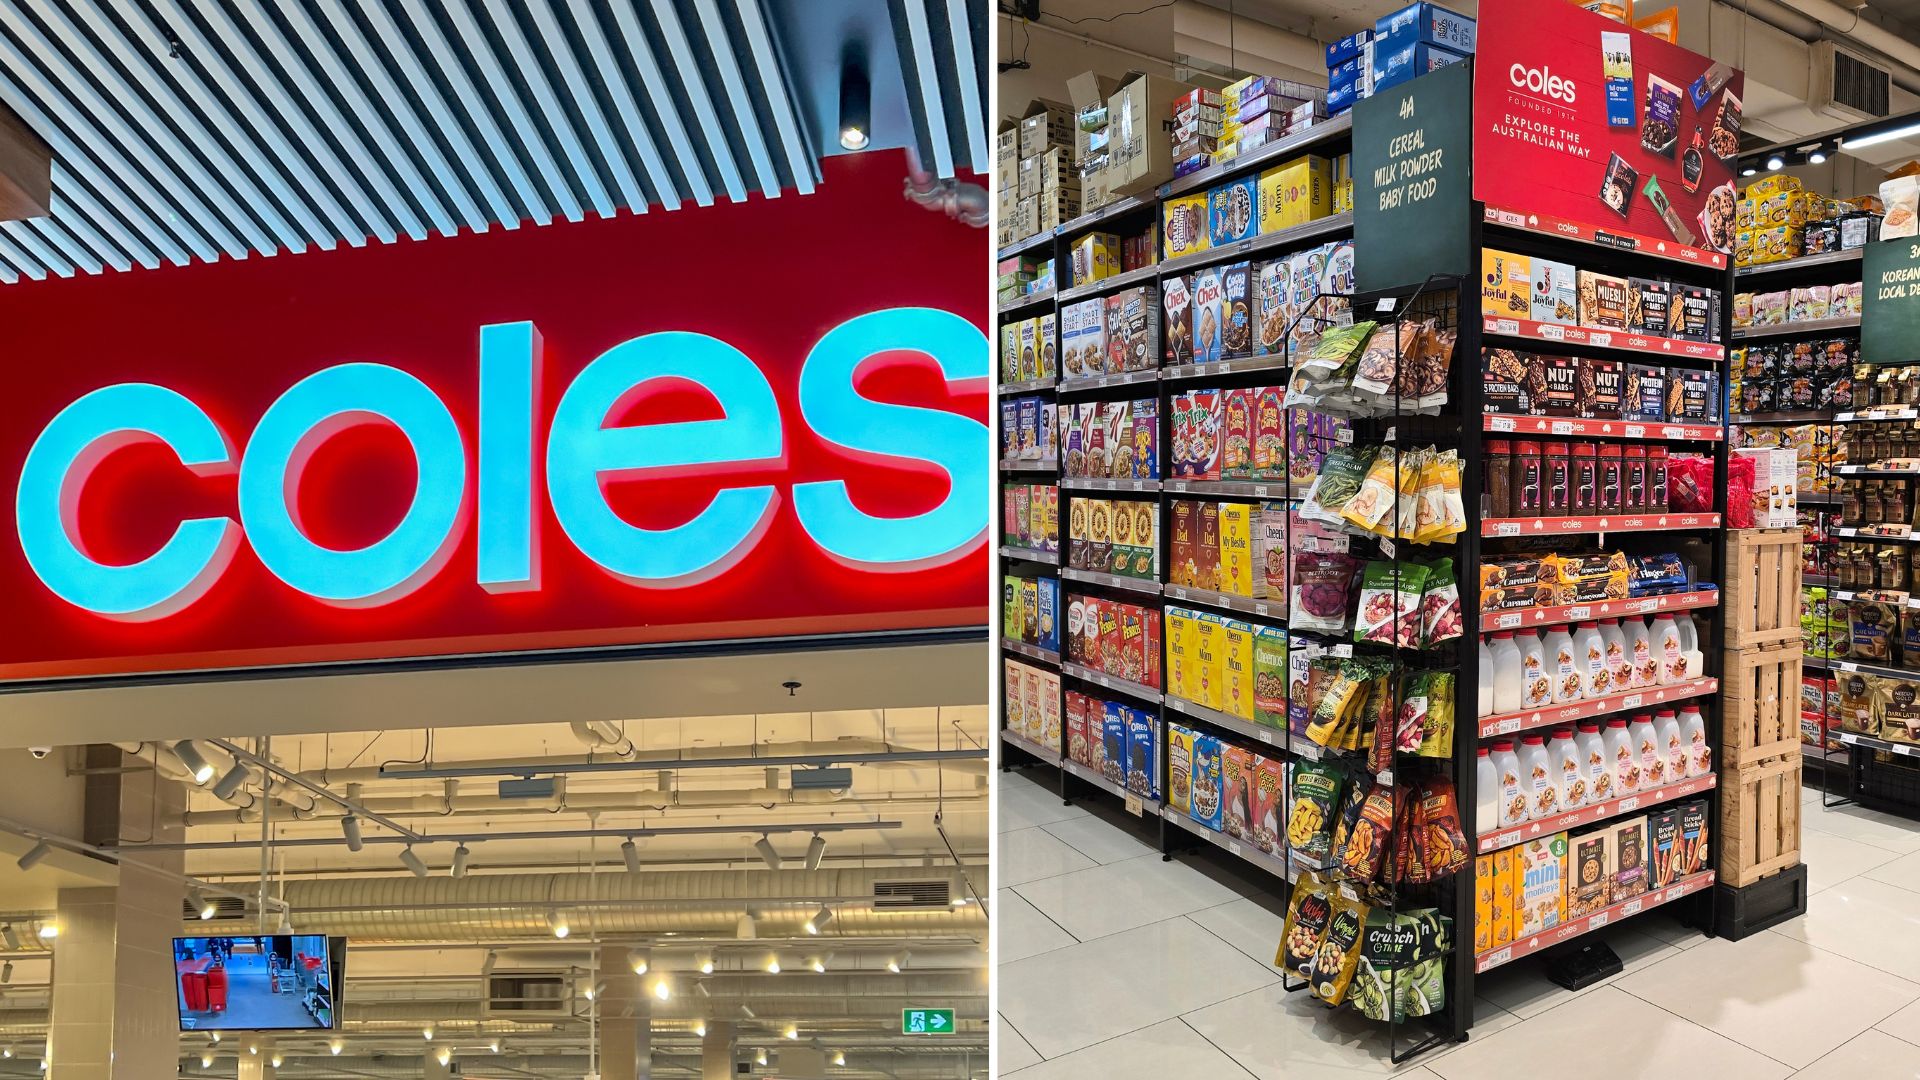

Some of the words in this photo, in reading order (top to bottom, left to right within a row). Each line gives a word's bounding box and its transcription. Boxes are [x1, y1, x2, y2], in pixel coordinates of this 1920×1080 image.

[1509, 63, 1576, 103] coles
[1400, 95, 1414, 119] 4A
[1508, 96, 1552, 115] FOUNDED
[1557, 110, 1575, 121] 1914
[1505, 113, 1555, 136] EXPLORE
[1559, 129, 1580, 143] THE
[1389, 129, 1424, 158] CEREAL
[1492, 123, 1564, 151] AUSTRALIAN
[1567, 143, 1590, 158] WAY
[1374, 163, 1397, 188] MILK
[1400, 148, 1442, 180] POWDER
[1379, 185, 1405, 211] BABY
[1407, 177, 1436, 204] FOOD
[1557, 223, 1578, 234] coles
[1681, 249, 1698, 259] coles
[1882, 267, 1920, 284] KOREAN
[1204, 279, 1214, 288] Rice
[1197, 286, 1219, 305] Chex
[1482, 287, 1507, 300] Joyful
[1598, 285, 1625, 303] MUESLI
[1642, 291, 1667, 304] PROTEIN
[1879, 285, 1906, 300] LOCAL
[1166, 290, 1185, 309] Chex
[1533, 294, 1555, 307] Joyful
[1685, 297, 1707, 310] PROTEIN
[1063, 322, 1078, 332] START
[1082, 317, 1099, 327] START
[1565, 329, 1586, 339] coles
[1628, 337, 1648, 347] coles
[1685, 344, 1702, 354] coles
[1547, 367, 1575, 384] NUT
[1596, 372, 1619, 387] NUT
[1553, 383, 1569, 391] BARS
[1640, 376, 1663, 388] PROTEIN
[1684, 380, 1707, 392] PROTEIN
[1601, 387, 1614, 395] BARS
[1172, 408, 1187, 429] Trix
[1188, 404, 1209, 427] Trix
[1684, 428, 1701, 437] coles
[16, 307, 988, 618] coles
[1562, 520, 1582, 529] coles
[1624, 518, 1643, 527] coles
[1681, 516, 1698, 525] coles
[1176, 529, 1188, 542] Dad
[1204, 532, 1215, 545] Dad
[1222, 535, 1230, 549] My
[1230, 537, 1246, 549] Bestie
[1581, 565, 1609, 574] Honeycomb
[1640, 568, 1665, 580] Finger
[1402, 583, 1416, 591] Apple
[1503, 575, 1537, 587] Caramel
[1576, 591, 1607, 602] Honeycomb
[1682, 595, 1698, 604] coles
[1501, 598, 1534, 608] Caramel
[1172, 642, 1184, 655] Mom
[1199, 648, 1212, 661] Mom
[1228, 657, 1242, 671] Mom
[1256, 649, 1283, 667] Cheerios
[1679, 686, 1696, 696] coles
[1560, 707, 1580, 718] coles
[1902, 711, 1920, 719] LATTE
[1105, 715, 1120, 723] OREO
[1130, 722, 1148, 732] OREO
[1678, 783, 1695, 794] coles
[1558, 814, 1579, 826] coles
[1684, 814, 1702, 822] Bread
[1658, 824, 1674, 834] Bread
[1619, 832, 1639, 843] ULTIMATE
[1556, 840, 1562, 850] 8
[1580, 845, 1601, 857] ULTIMATE
[1525, 863, 1559, 888] mini
[1525, 882, 1559, 899] monkeys
[1543, 911, 1559, 926] mini
[1558, 924, 1577, 938] coles
